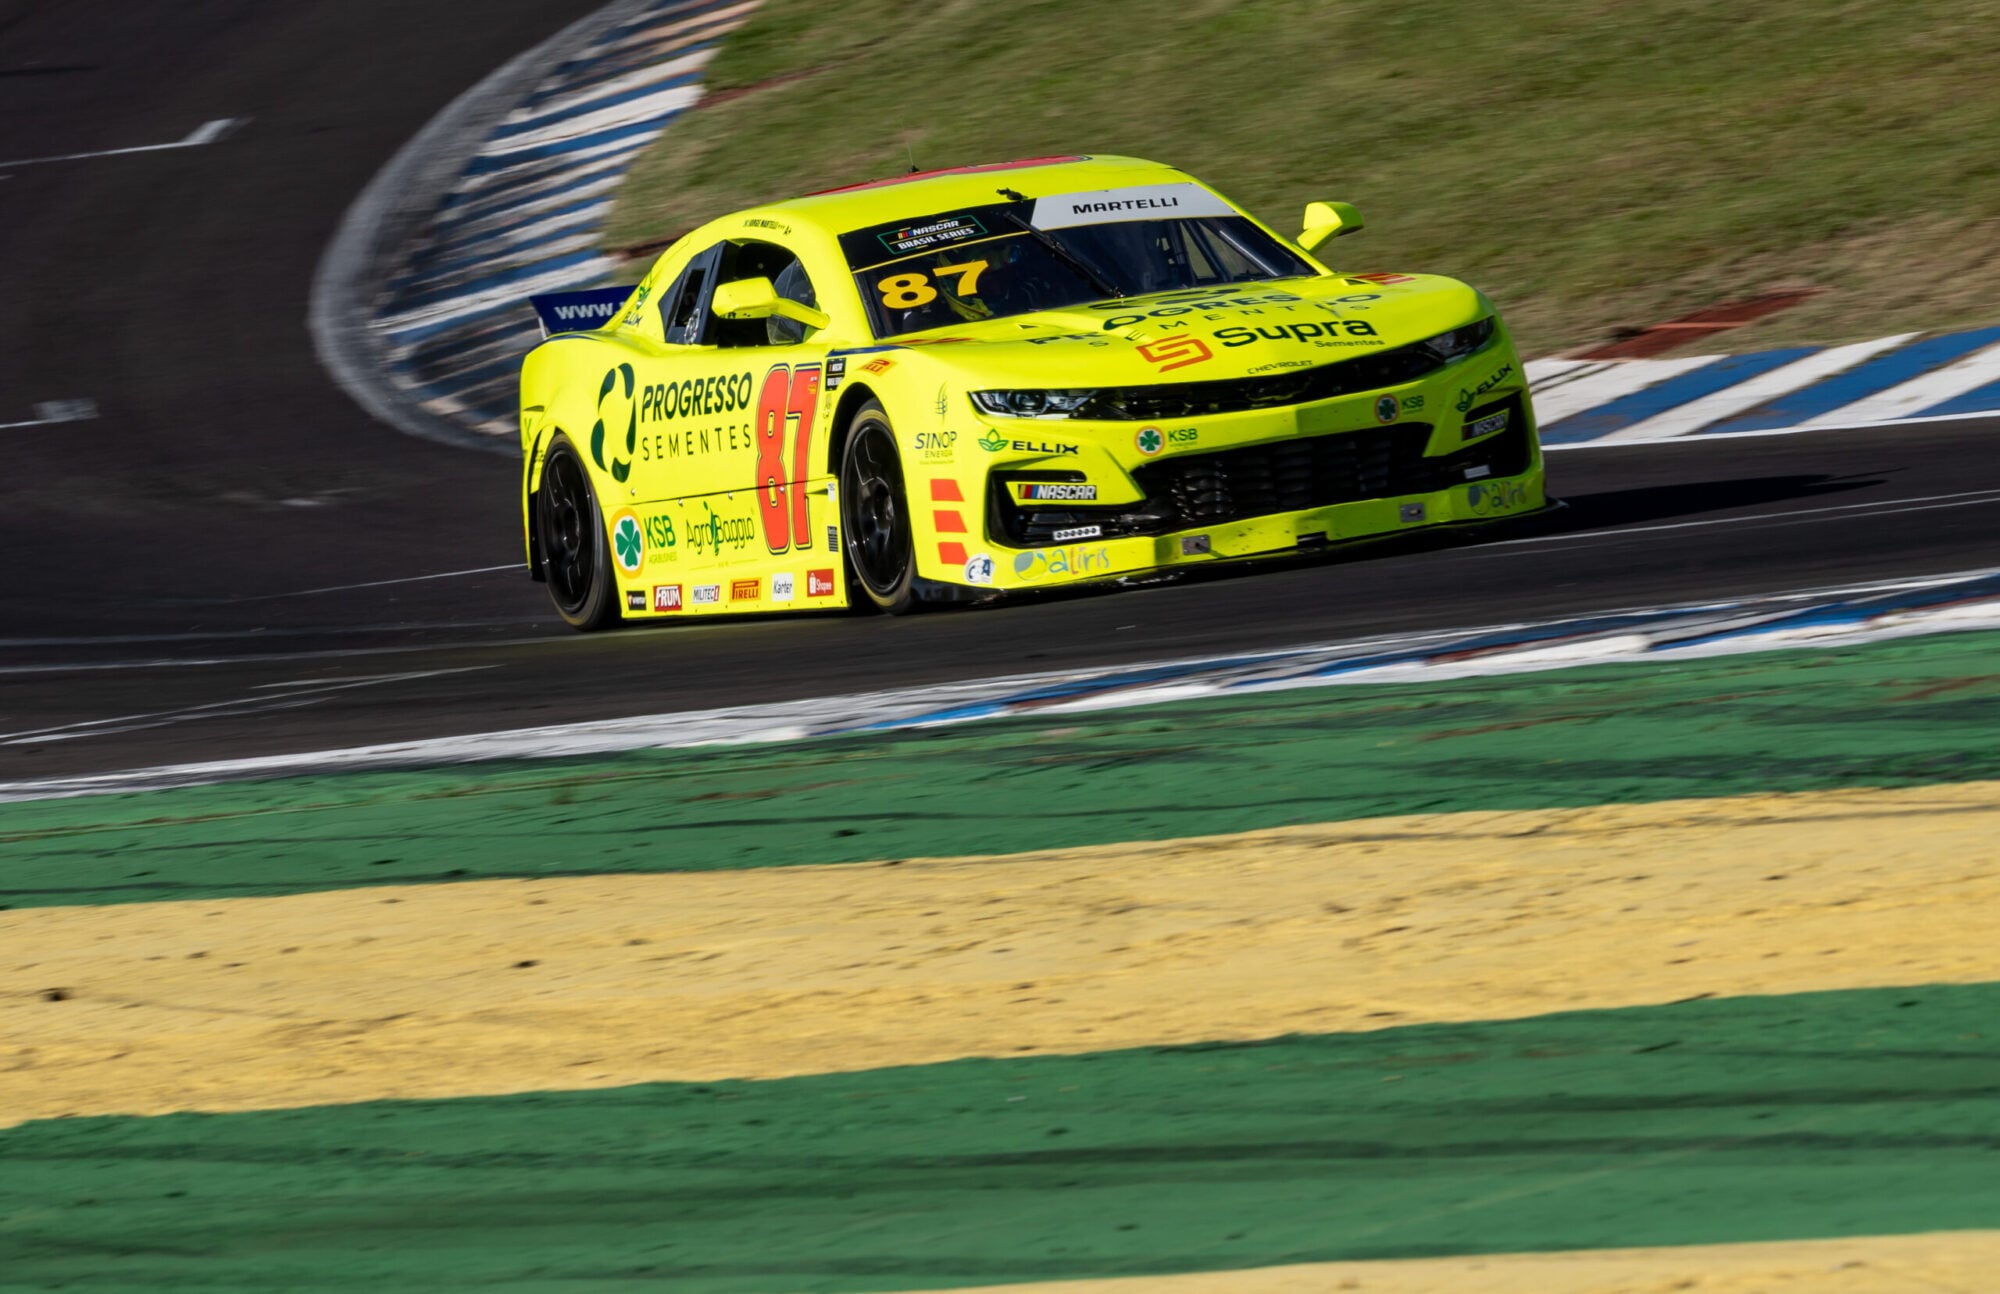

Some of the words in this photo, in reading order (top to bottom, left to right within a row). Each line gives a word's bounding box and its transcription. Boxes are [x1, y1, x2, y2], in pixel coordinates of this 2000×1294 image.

[1072, 197, 1179, 215] MARTELLI
[912, 220, 960, 236] NASCAR
[897, 236, 938, 250] BRASIL
[937, 227, 975, 241] SERIES
[877, 259, 989, 310] 87
[1212, 318, 1378, 348] Supra
[1314, 338, 1385, 349] Sementes
[1247, 359, 1314, 375] CHEVROLET
[641, 371, 753, 423] PROGRESSO
[1401, 395, 1425, 410] KSB
[642, 423, 752, 462] SEMENTES
[914, 431, 957, 450] SINOP
[1168, 428, 1198, 442] KSB
[1012, 440, 1079, 455] ELLIX
[756, 362, 822, 556] 87
[1036, 485, 1096, 500] NASCAR
[643, 514, 676, 550] KSB
[732, 580, 759, 600] PIRELLI
[816, 578, 832, 593] Shopee
[655, 586, 682, 607] FRUM
